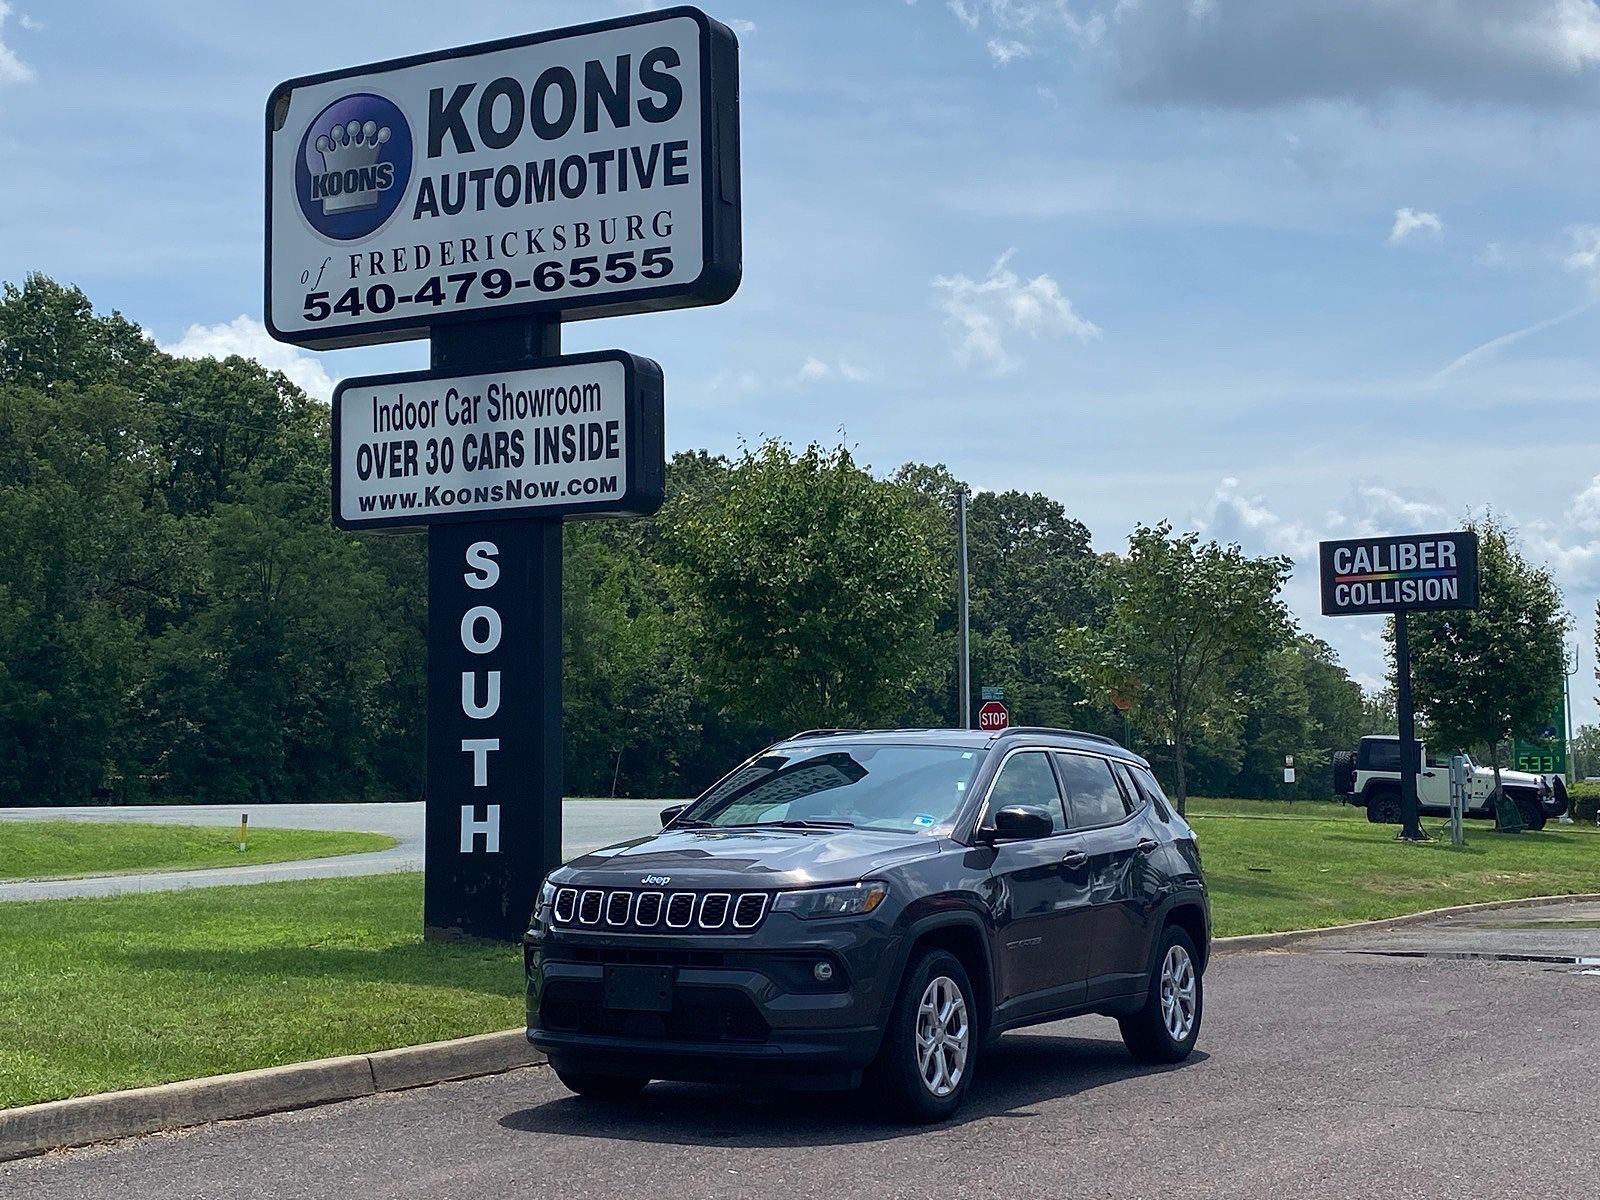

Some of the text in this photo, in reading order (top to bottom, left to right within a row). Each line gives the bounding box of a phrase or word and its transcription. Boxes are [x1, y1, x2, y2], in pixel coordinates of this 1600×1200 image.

[427, 46, 683, 159] KOONS
[312, 162, 395, 201] KOONS
[412, 139, 690, 220] AUTOMOTIVE
[300, 210, 674, 291] of FREDERICKSBURG
[302, 246, 675, 322] 540-479-6555
[373, 382, 601, 433] Indoor Car Showroom
[356, 420, 620, 481] OVER 30 CARS INSIDE
[1333, 540, 1457, 575] CALIBER
[1335, 577, 1458, 607] COLLISION
[460, 541, 502, 853] SOUTH
[981, 712, 1007, 726] STOP
[641, 874, 671, 886] Jeep
